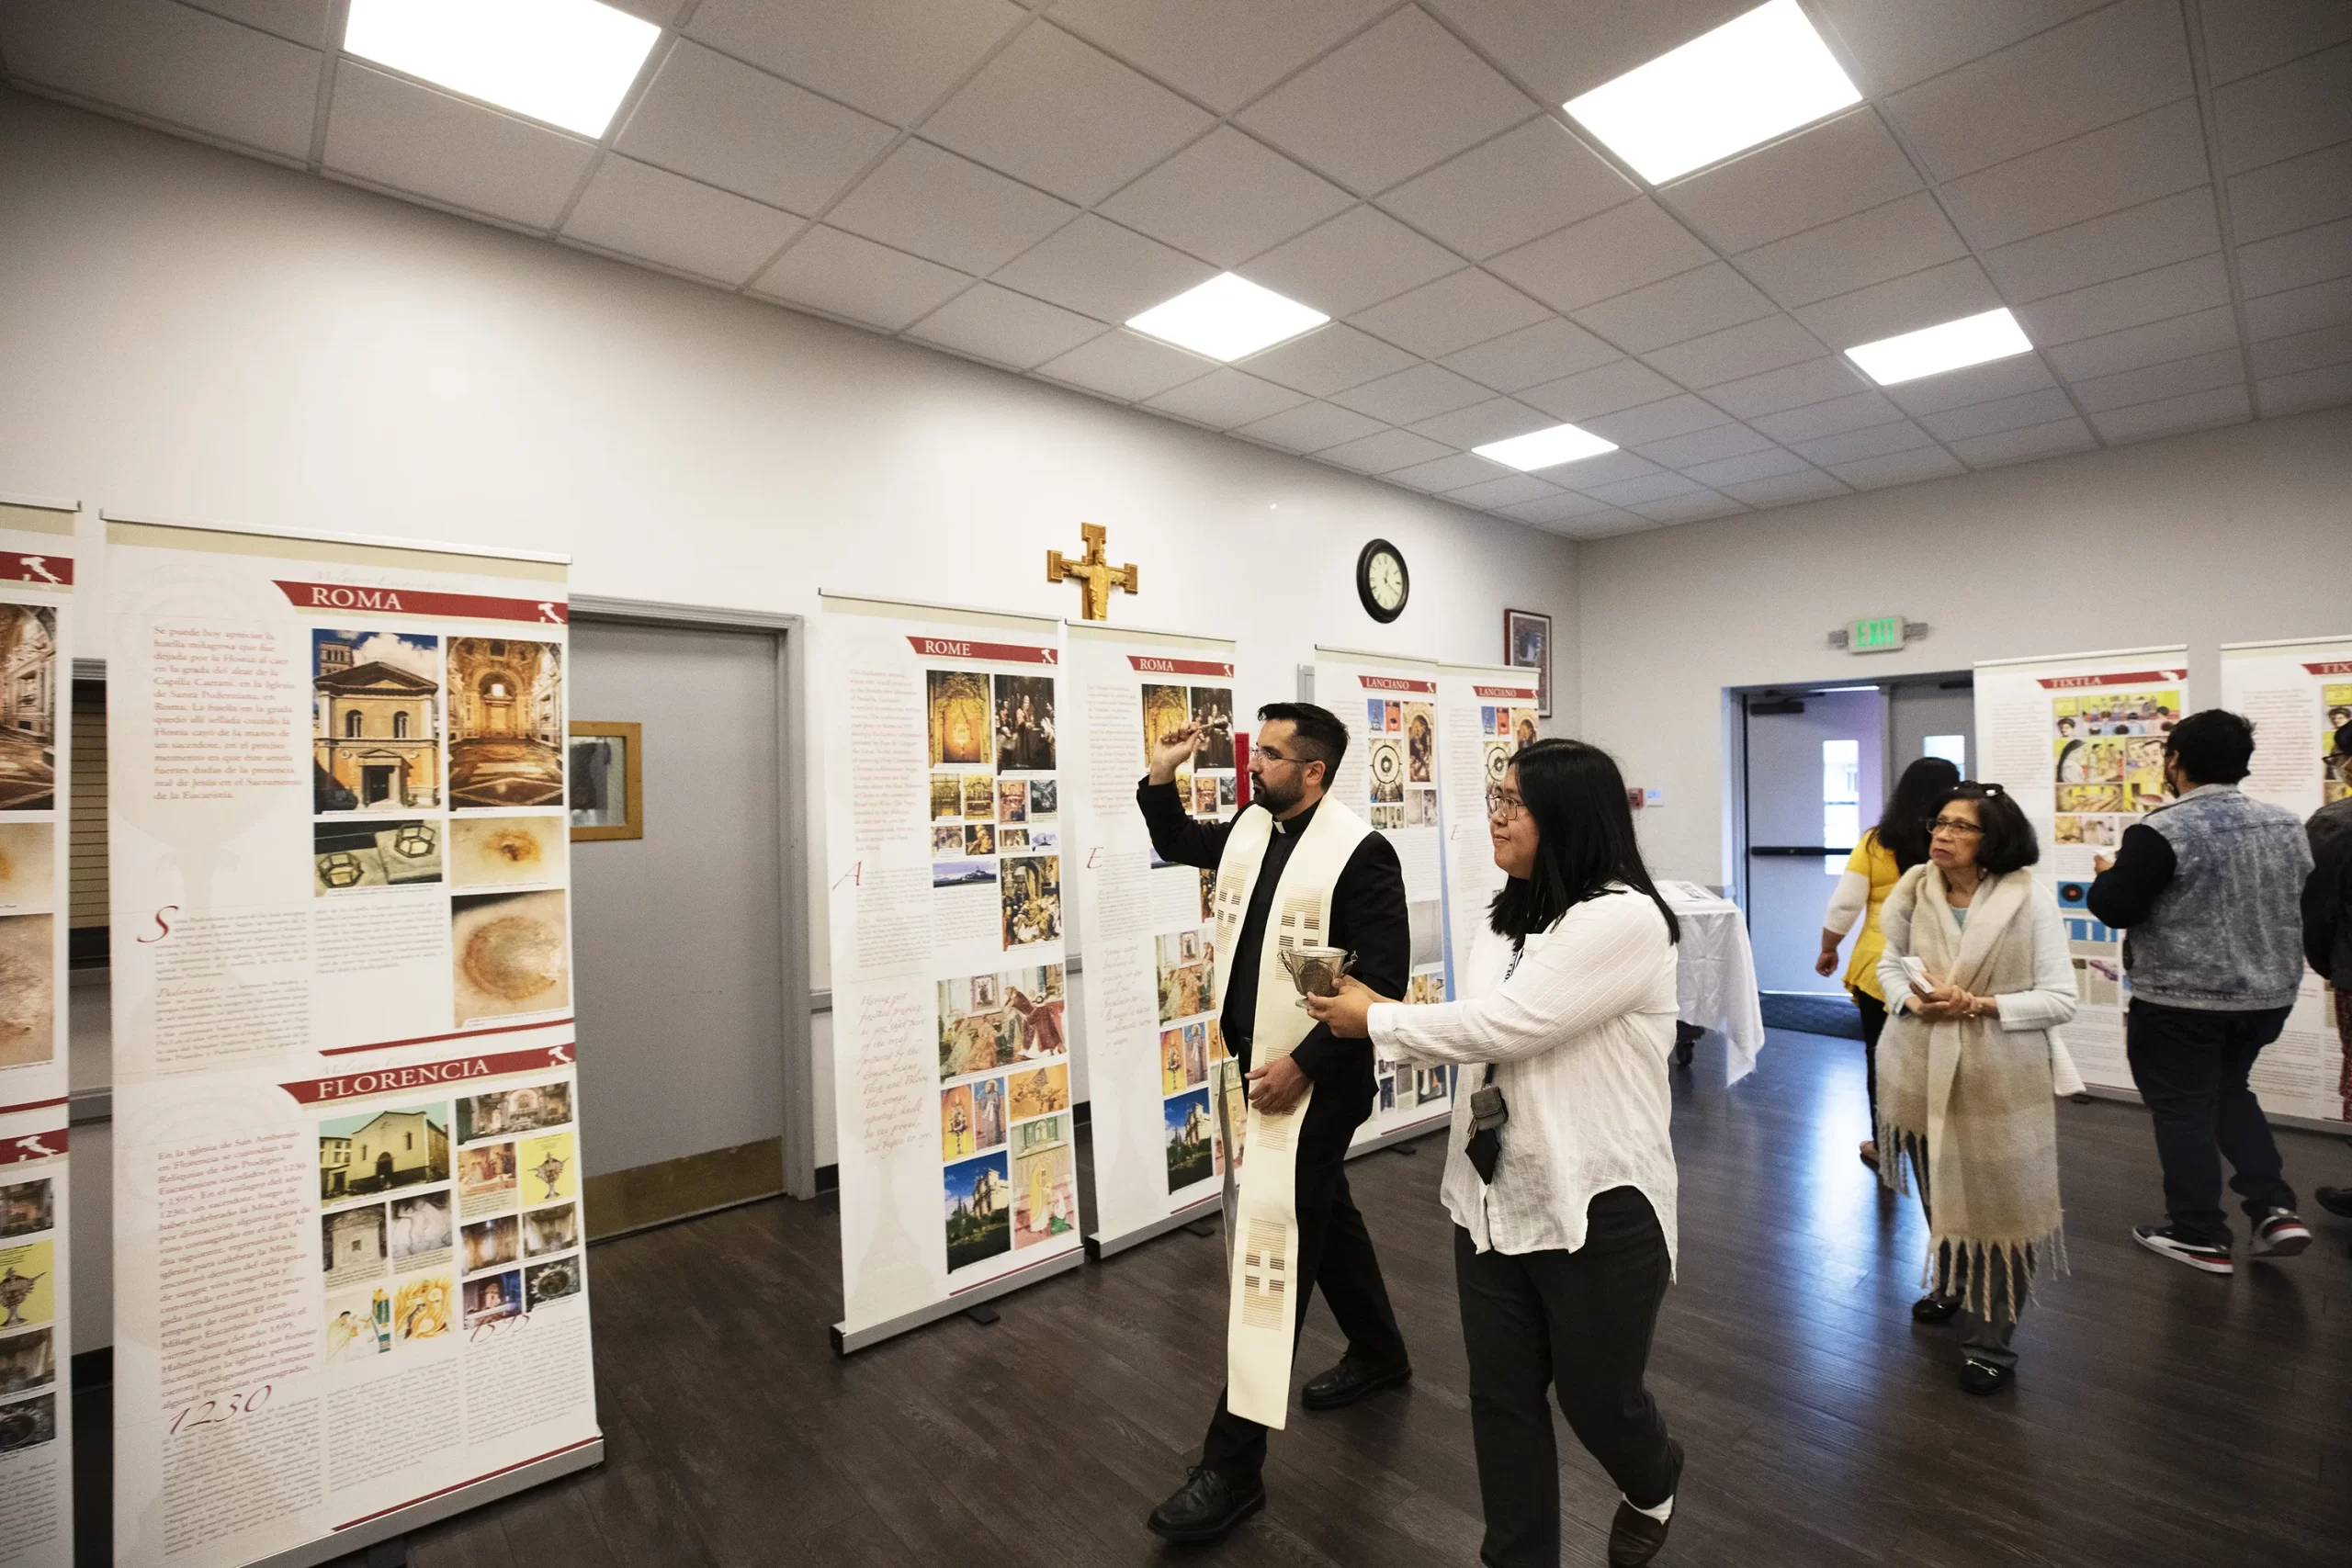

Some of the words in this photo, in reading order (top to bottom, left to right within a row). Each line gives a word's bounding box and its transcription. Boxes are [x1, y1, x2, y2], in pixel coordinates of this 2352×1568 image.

[310, 587, 402, 610] ROMA
[1857, 617, 1895, 647] EXIT
[925, 640, 971, 656] ROME
[1139, 659, 1174, 671] ROMA
[1366, 678, 1409, 690] LANCIANO
[2050, 677, 2102, 688] TIXTLA
[1478, 688, 1517, 697] LANCIANO
[317, 1060, 490, 1100] FLORENCIA
[169, 1385, 273, 1435] 1230
